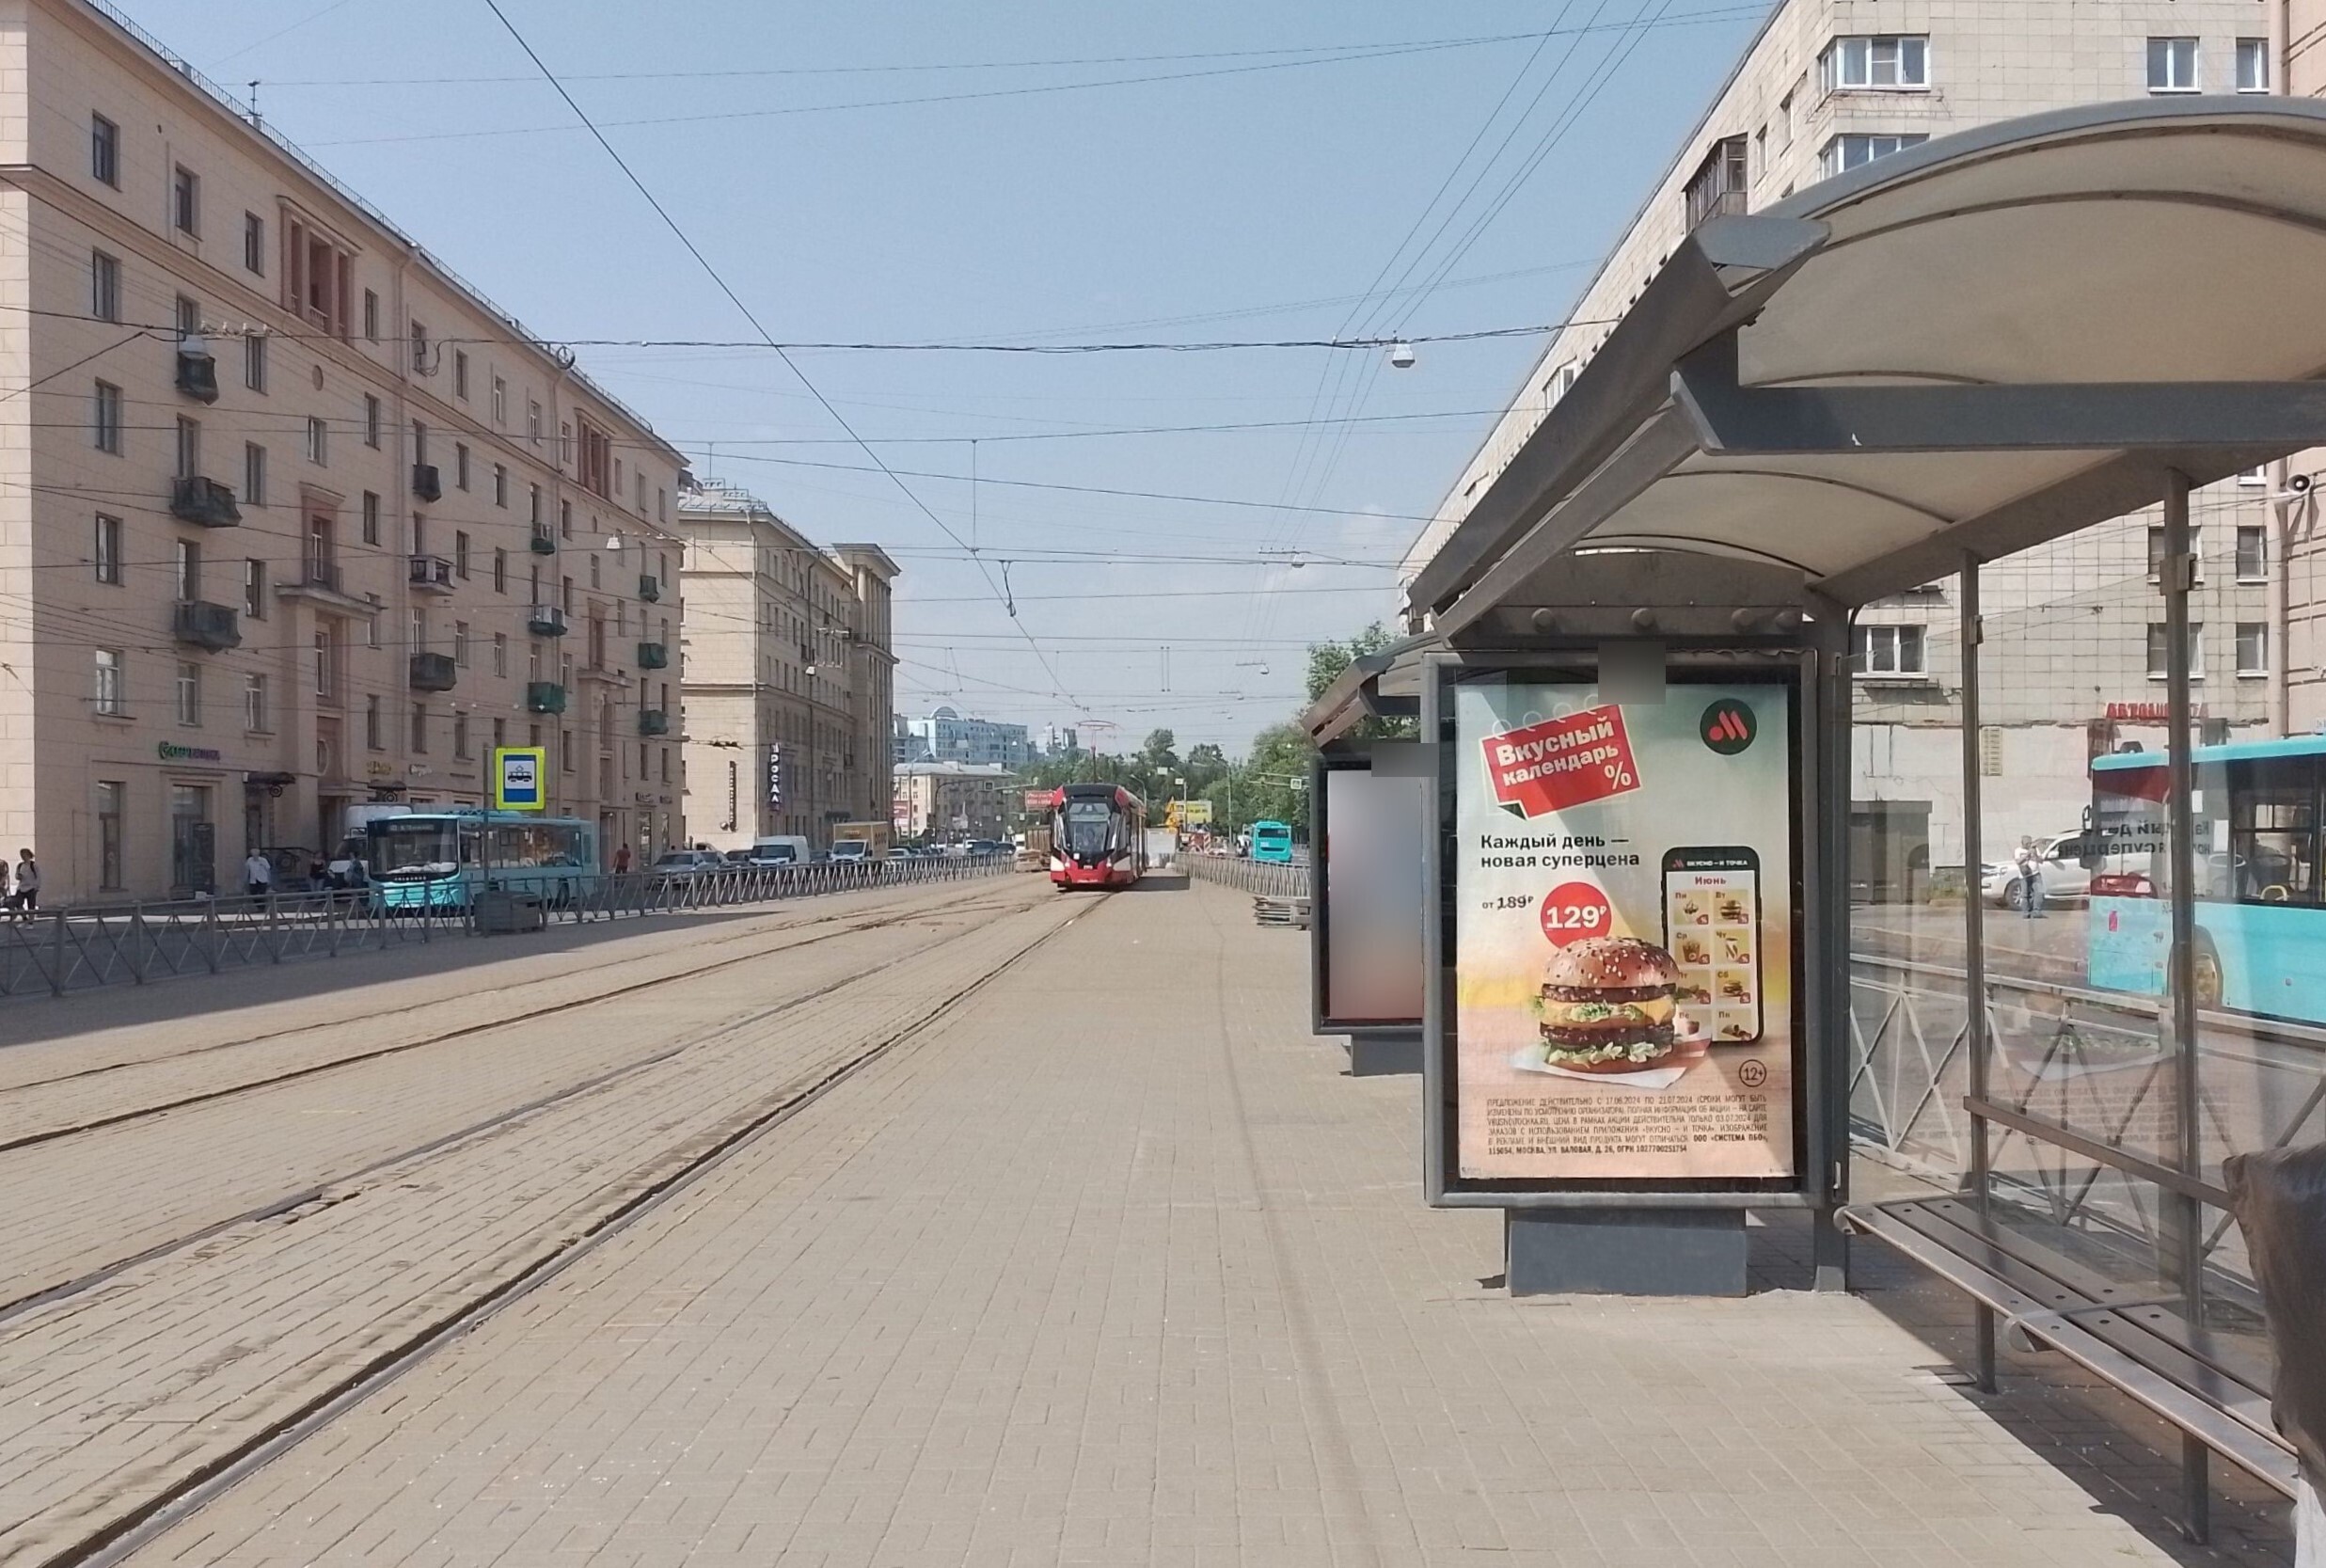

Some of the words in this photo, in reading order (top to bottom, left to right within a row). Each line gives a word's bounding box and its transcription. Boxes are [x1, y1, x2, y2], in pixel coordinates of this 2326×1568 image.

[2106, 702, 2209, 721] АВТОШЛА
[1495, 715, 1615, 768] Вкусный
[1502, 744, 1619, 786] календарь
[1604, 761, 1632, 790] %
[1480, 833, 1557, 850] Каждый
[1561, 834, 1606, 849] день
[1480, 855, 1537, 868] новая
[1542, 853, 1640, 870] суперцена
[1695, 876, 1727, 885] Июнь
[1481, 901, 1494, 910] от
[1744, 1067, 1764, 1081] 12+
[1540, 1097, 1592, 1106] ДЕЙСТВИТЕЛЬНО
[1607, 1117, 1630, 1125] АКЦИИ
[1633, 1116, 1685, 1124] ДЕЙСТВИТЕЛЬНА
[1753, 1114, 1767, 1122] ДЛЯ
[1593, 1126, 1638, 1134] ПРИЛОЖЕНИЯ
[1574, 1136, 1588, 1145] ВИД
[1590, 1135, 1622, 1144] ПРОДУКТА
